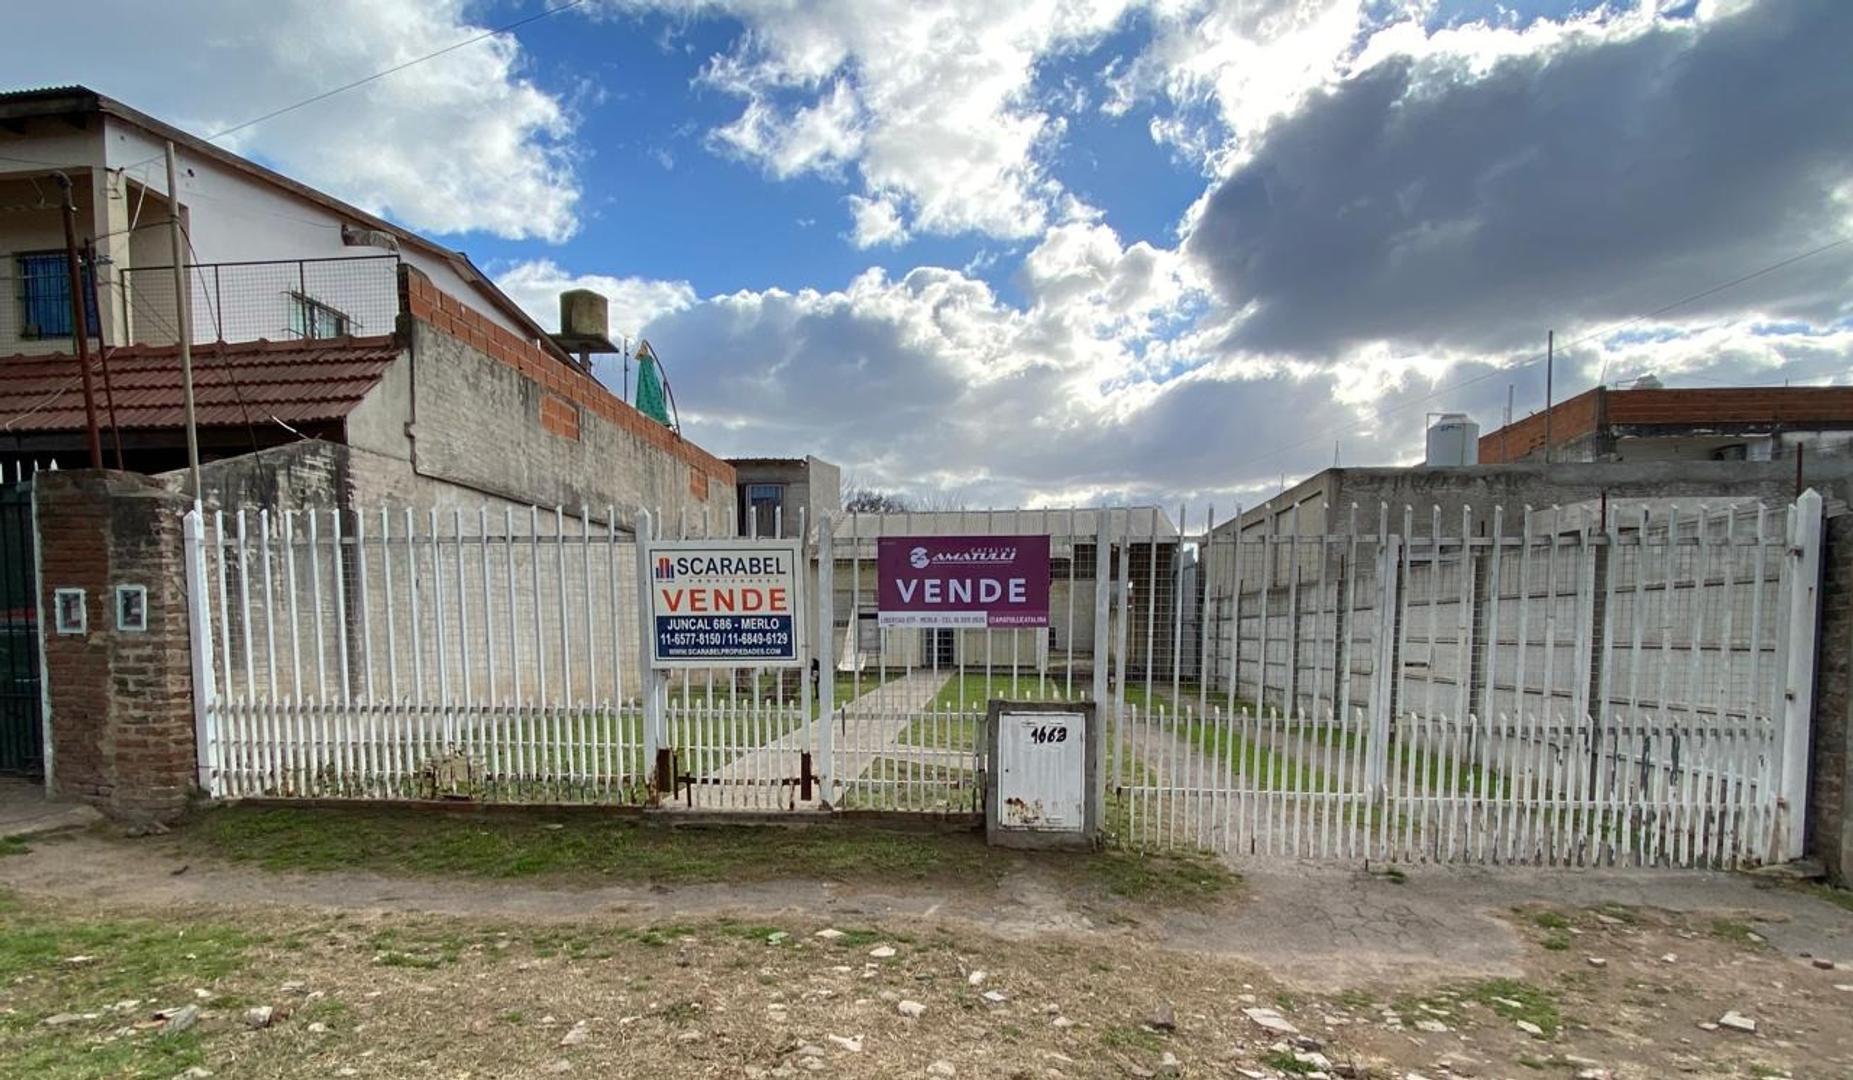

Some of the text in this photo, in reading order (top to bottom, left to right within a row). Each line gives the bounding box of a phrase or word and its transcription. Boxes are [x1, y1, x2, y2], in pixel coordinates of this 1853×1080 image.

[676, 557, 787, 575] SCARABEL
[662, 588, 788, 612] VENDE
[895, 578, 1027, 604] VENDE
[667, 618, 711, 630] JUNCAL
[741, 618, 780, 630] MERLO
